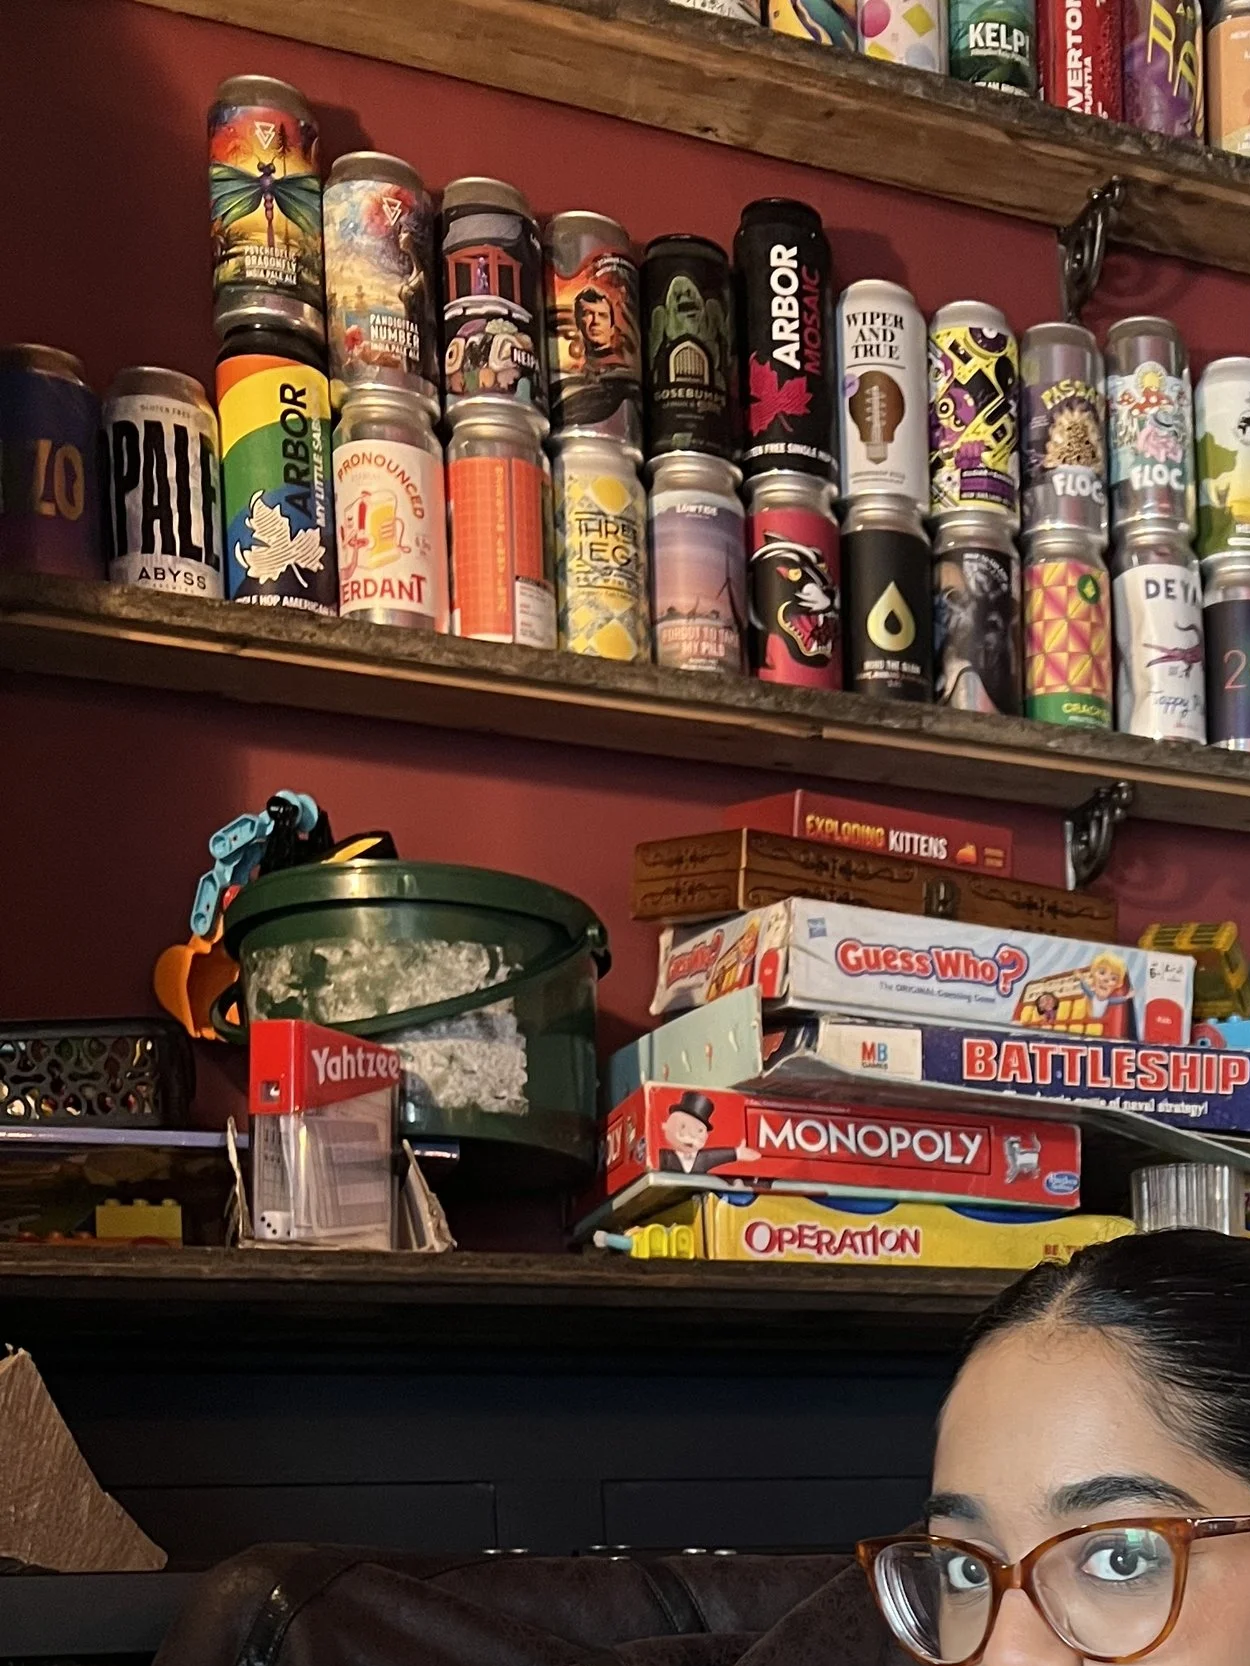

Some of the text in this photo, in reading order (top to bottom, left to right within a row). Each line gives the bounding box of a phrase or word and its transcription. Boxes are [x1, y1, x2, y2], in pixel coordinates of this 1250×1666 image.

[770, 243, 801, 371] ARBOR
[802, 264, 822, 377] MOSAIC
[845, 311, 905, 331] WIPER
[370, 325, 420, 348] NUMBER
[851, 344, 901, 362] TRUE
[855, 327, 896, 344] AND
[279, 382, 313, 520] ARBOR
[112, 419, 220, 572] PALE
[312, 453, 326, 501] LITTLE
[337, 451, 426, 521] PRONOUNCED
[138, 566, 208, 591] ABYSS
[341, 573, 427, 605] ERDANT
[805, 814, 948, 861] EXPLODING KITTENS
[835, 936, 934, 978] Guess
[311, 1045, 400, 1086] Yahtzee
[757, 1115, 984, 1167] MONOPOLY
[743, 1221, 921, 1258] OPERATION
